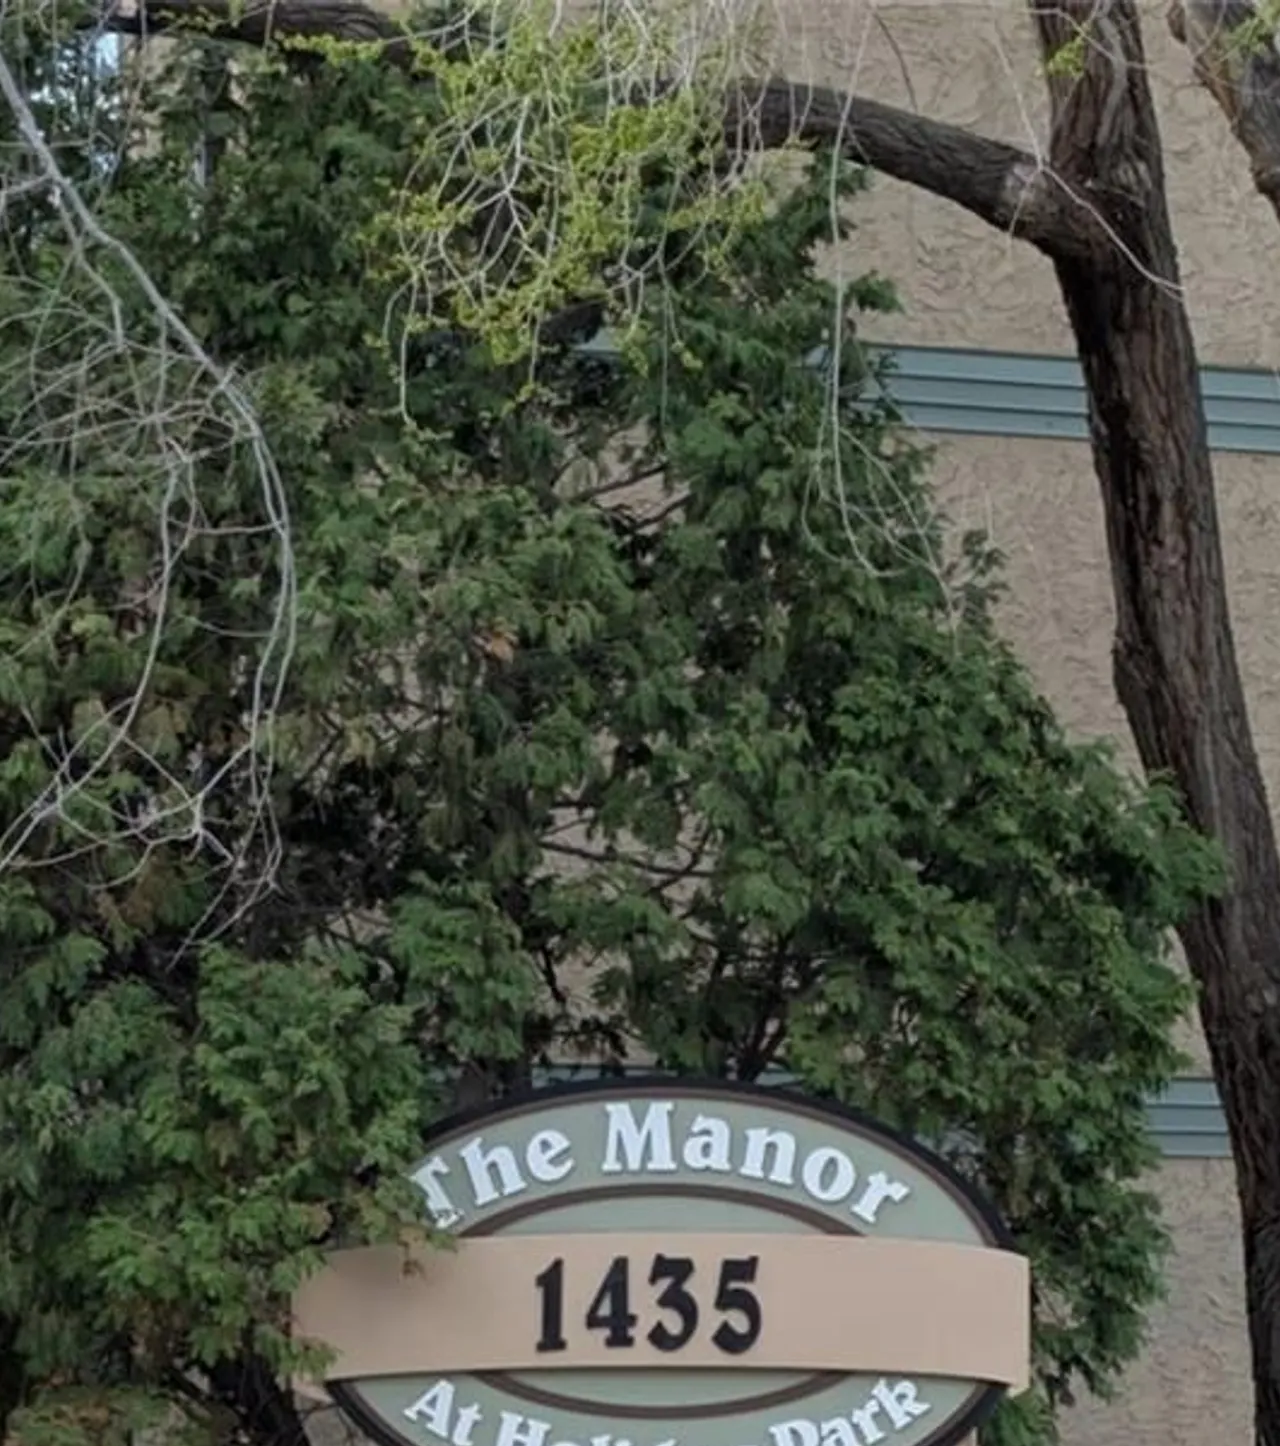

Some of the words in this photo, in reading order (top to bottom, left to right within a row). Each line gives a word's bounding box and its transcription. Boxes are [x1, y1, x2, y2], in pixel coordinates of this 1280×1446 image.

[409, 1126, 575, 1230] The
[601, 1100, 911, 1225] Manor
[534, 1252, 763, 1355] 1435
